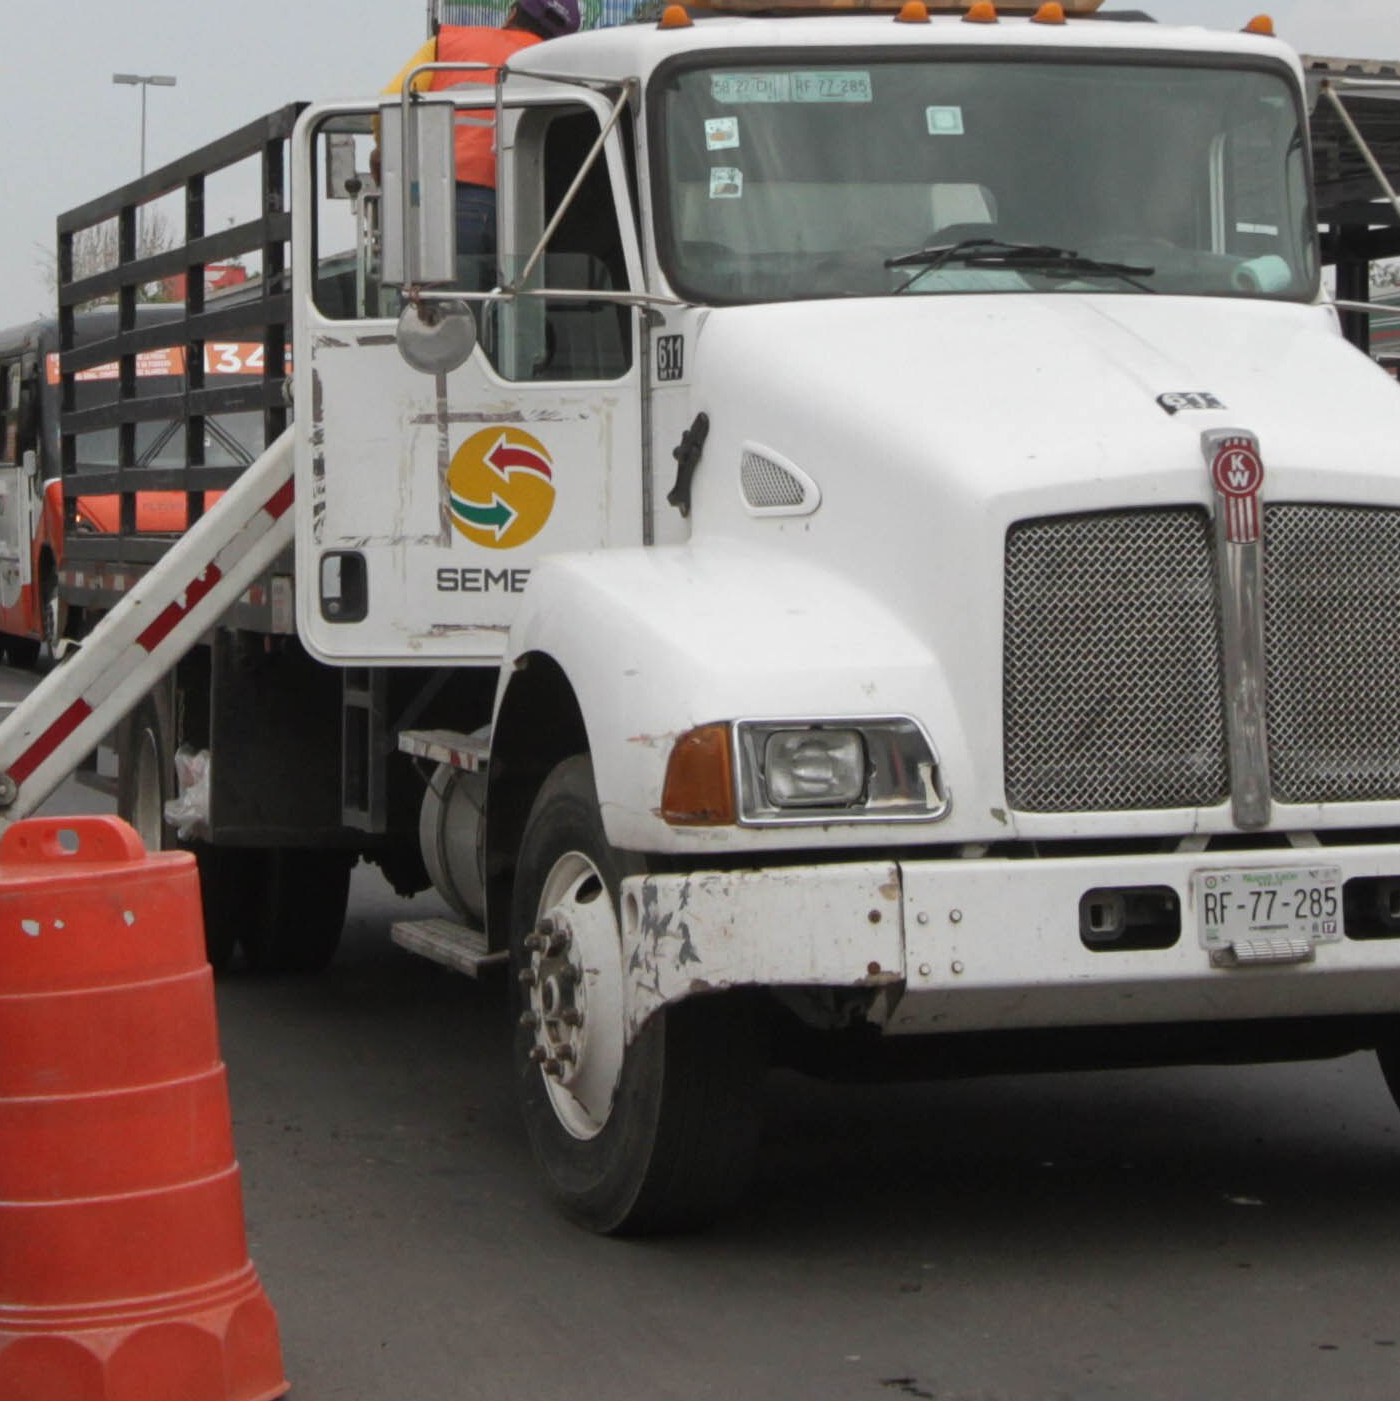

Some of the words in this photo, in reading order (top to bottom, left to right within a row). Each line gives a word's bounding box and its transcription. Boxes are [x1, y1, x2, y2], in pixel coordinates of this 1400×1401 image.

[659, 337, 681, 369] 611
[1231, 454, 1245, 470] K
[1227, 471, 1250, 488] W
[437, 568, 531, 593] SEME
[1204, 886, 1337, 926] RF-77-285
